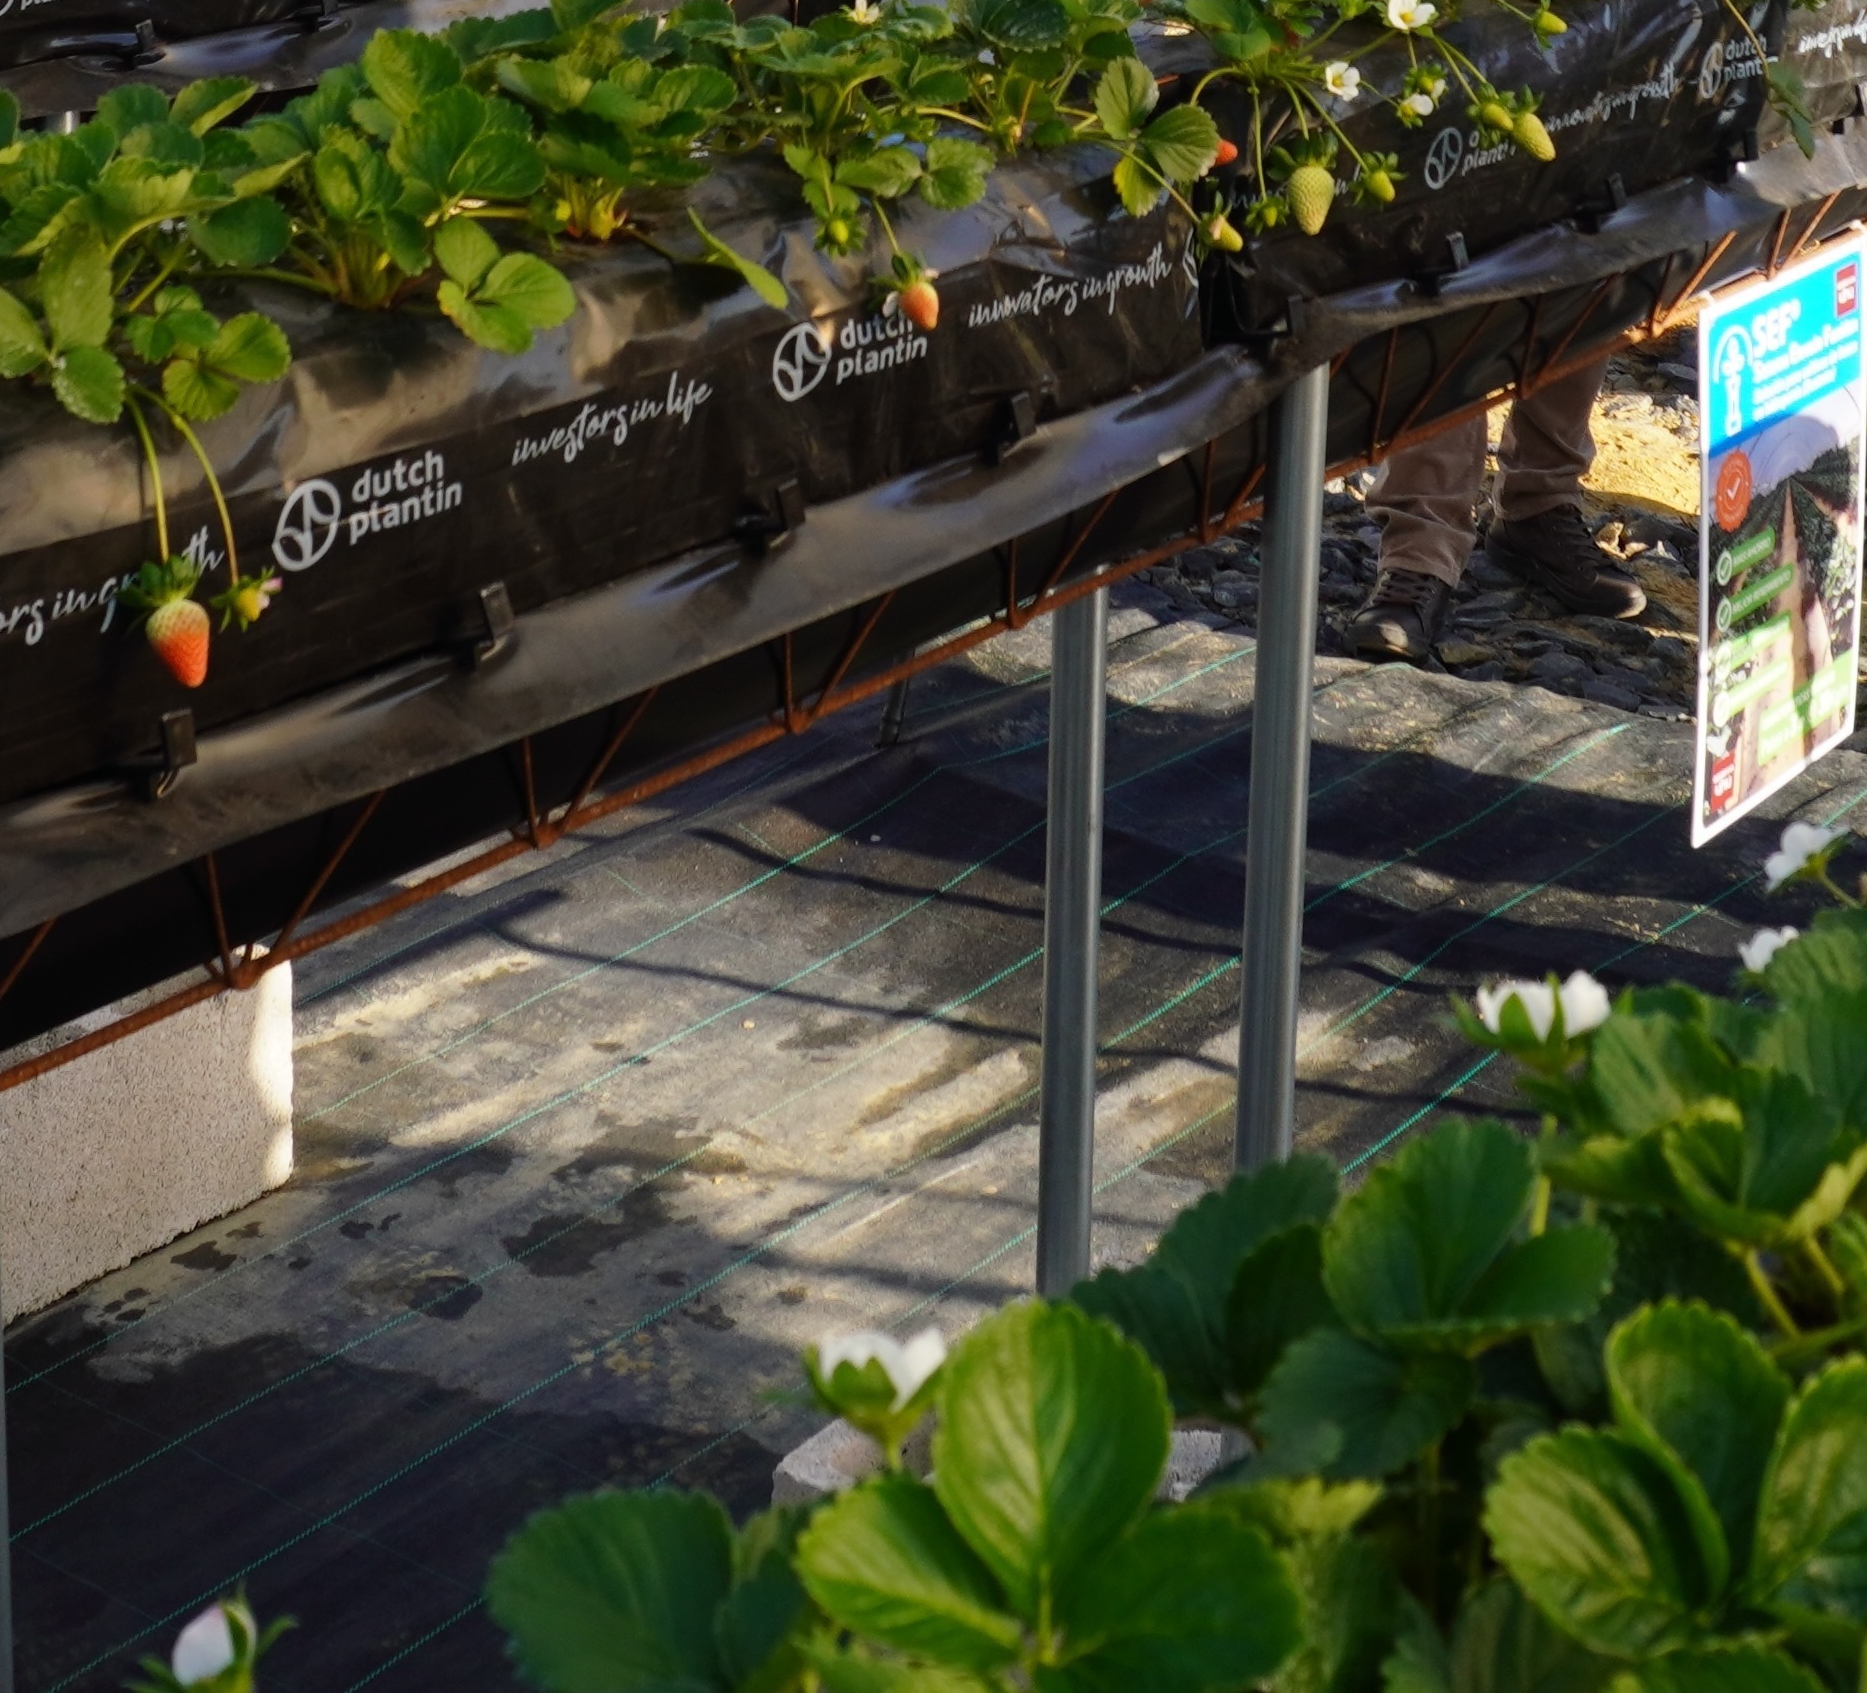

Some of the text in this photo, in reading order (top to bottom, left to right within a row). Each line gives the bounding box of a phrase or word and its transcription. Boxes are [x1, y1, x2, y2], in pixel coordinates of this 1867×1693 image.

[967, 272, 1077, 328] innovators
[835, 333, 928, 386] plantin
[511, 402, 629, 466] investors
[664, 369, 714, 425] life
[351, 449, 445, 504] dutch
[348, 480, 463, 547] plantin
